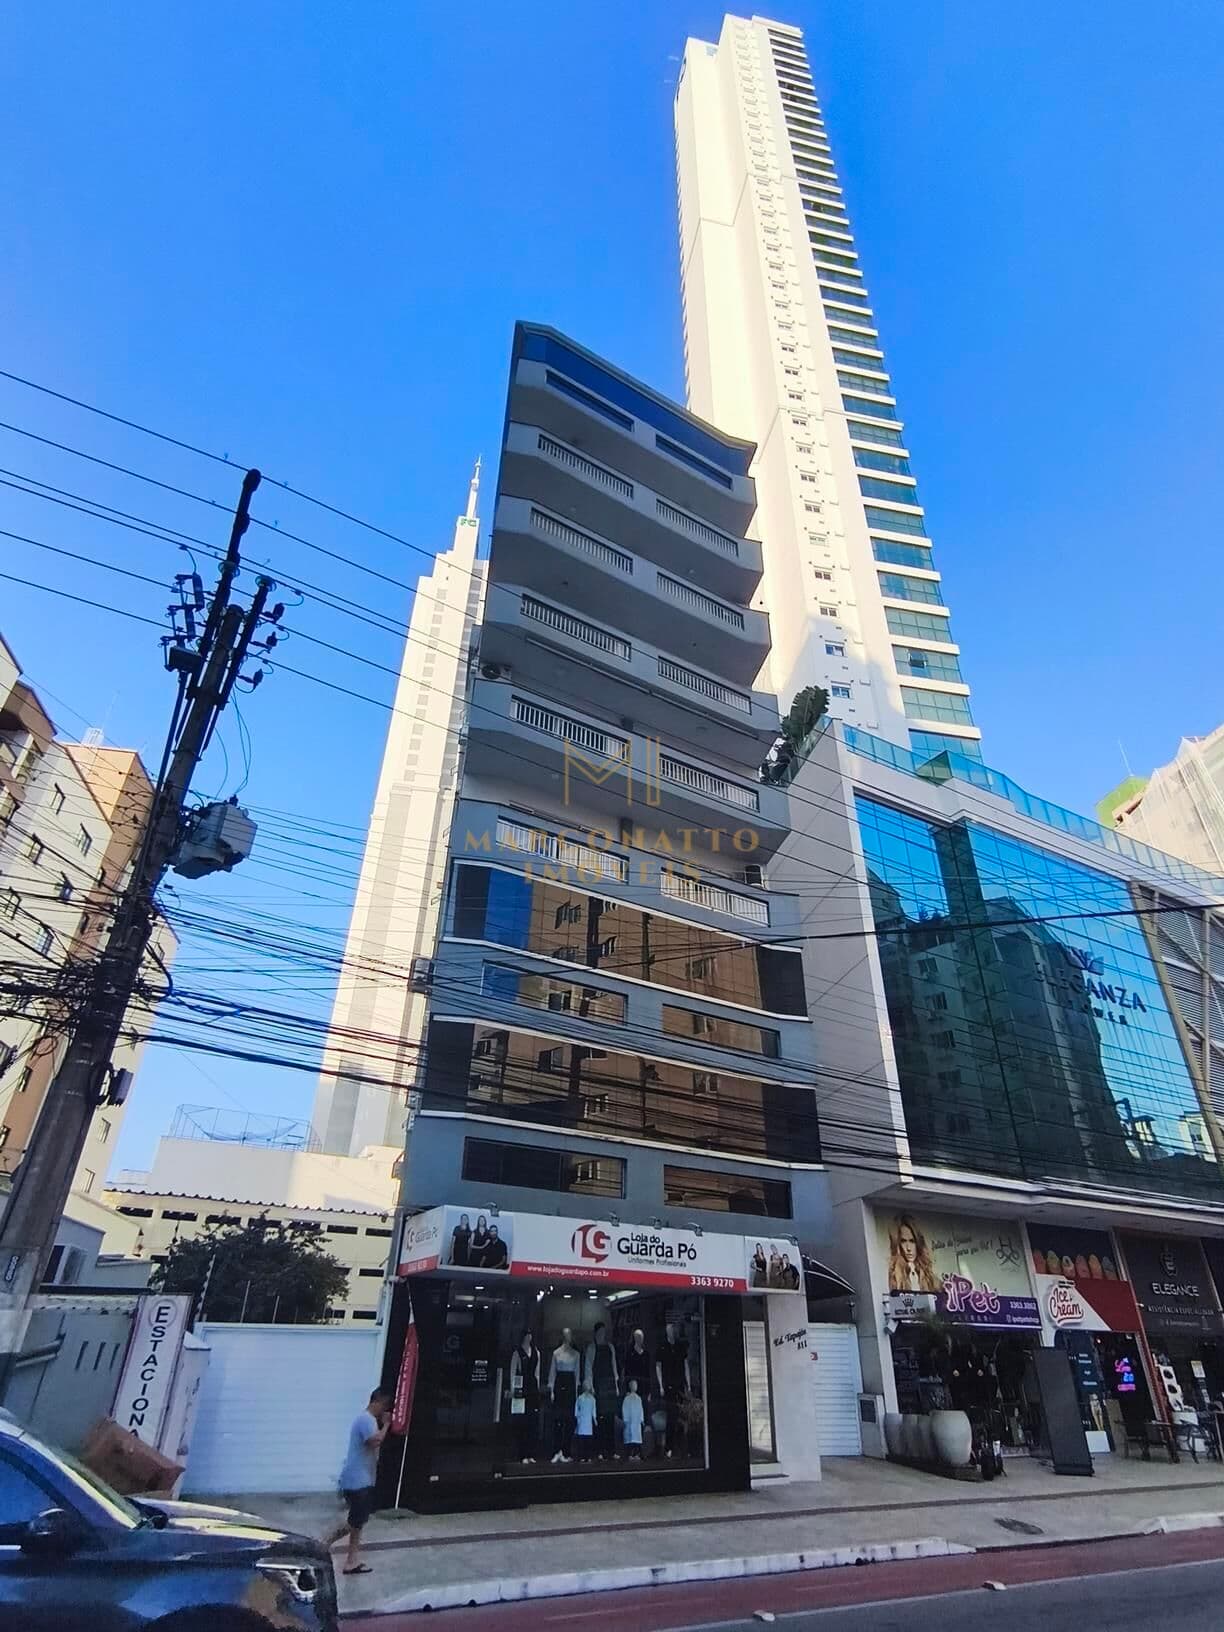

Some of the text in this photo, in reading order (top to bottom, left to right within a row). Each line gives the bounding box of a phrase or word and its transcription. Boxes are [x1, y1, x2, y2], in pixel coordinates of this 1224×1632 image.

[630, 1232, 660, 1244] Loja do
[617, 1237, 697, 1260] Guarda Pó
[690, 1276, 734, 1288] 3363 9270
[1152, 1282, 1200, 1297] ELEGANCE
[1053, 1287, 1069, 1303] Ice
[1050, 1296, 1082, 1319] Cream
